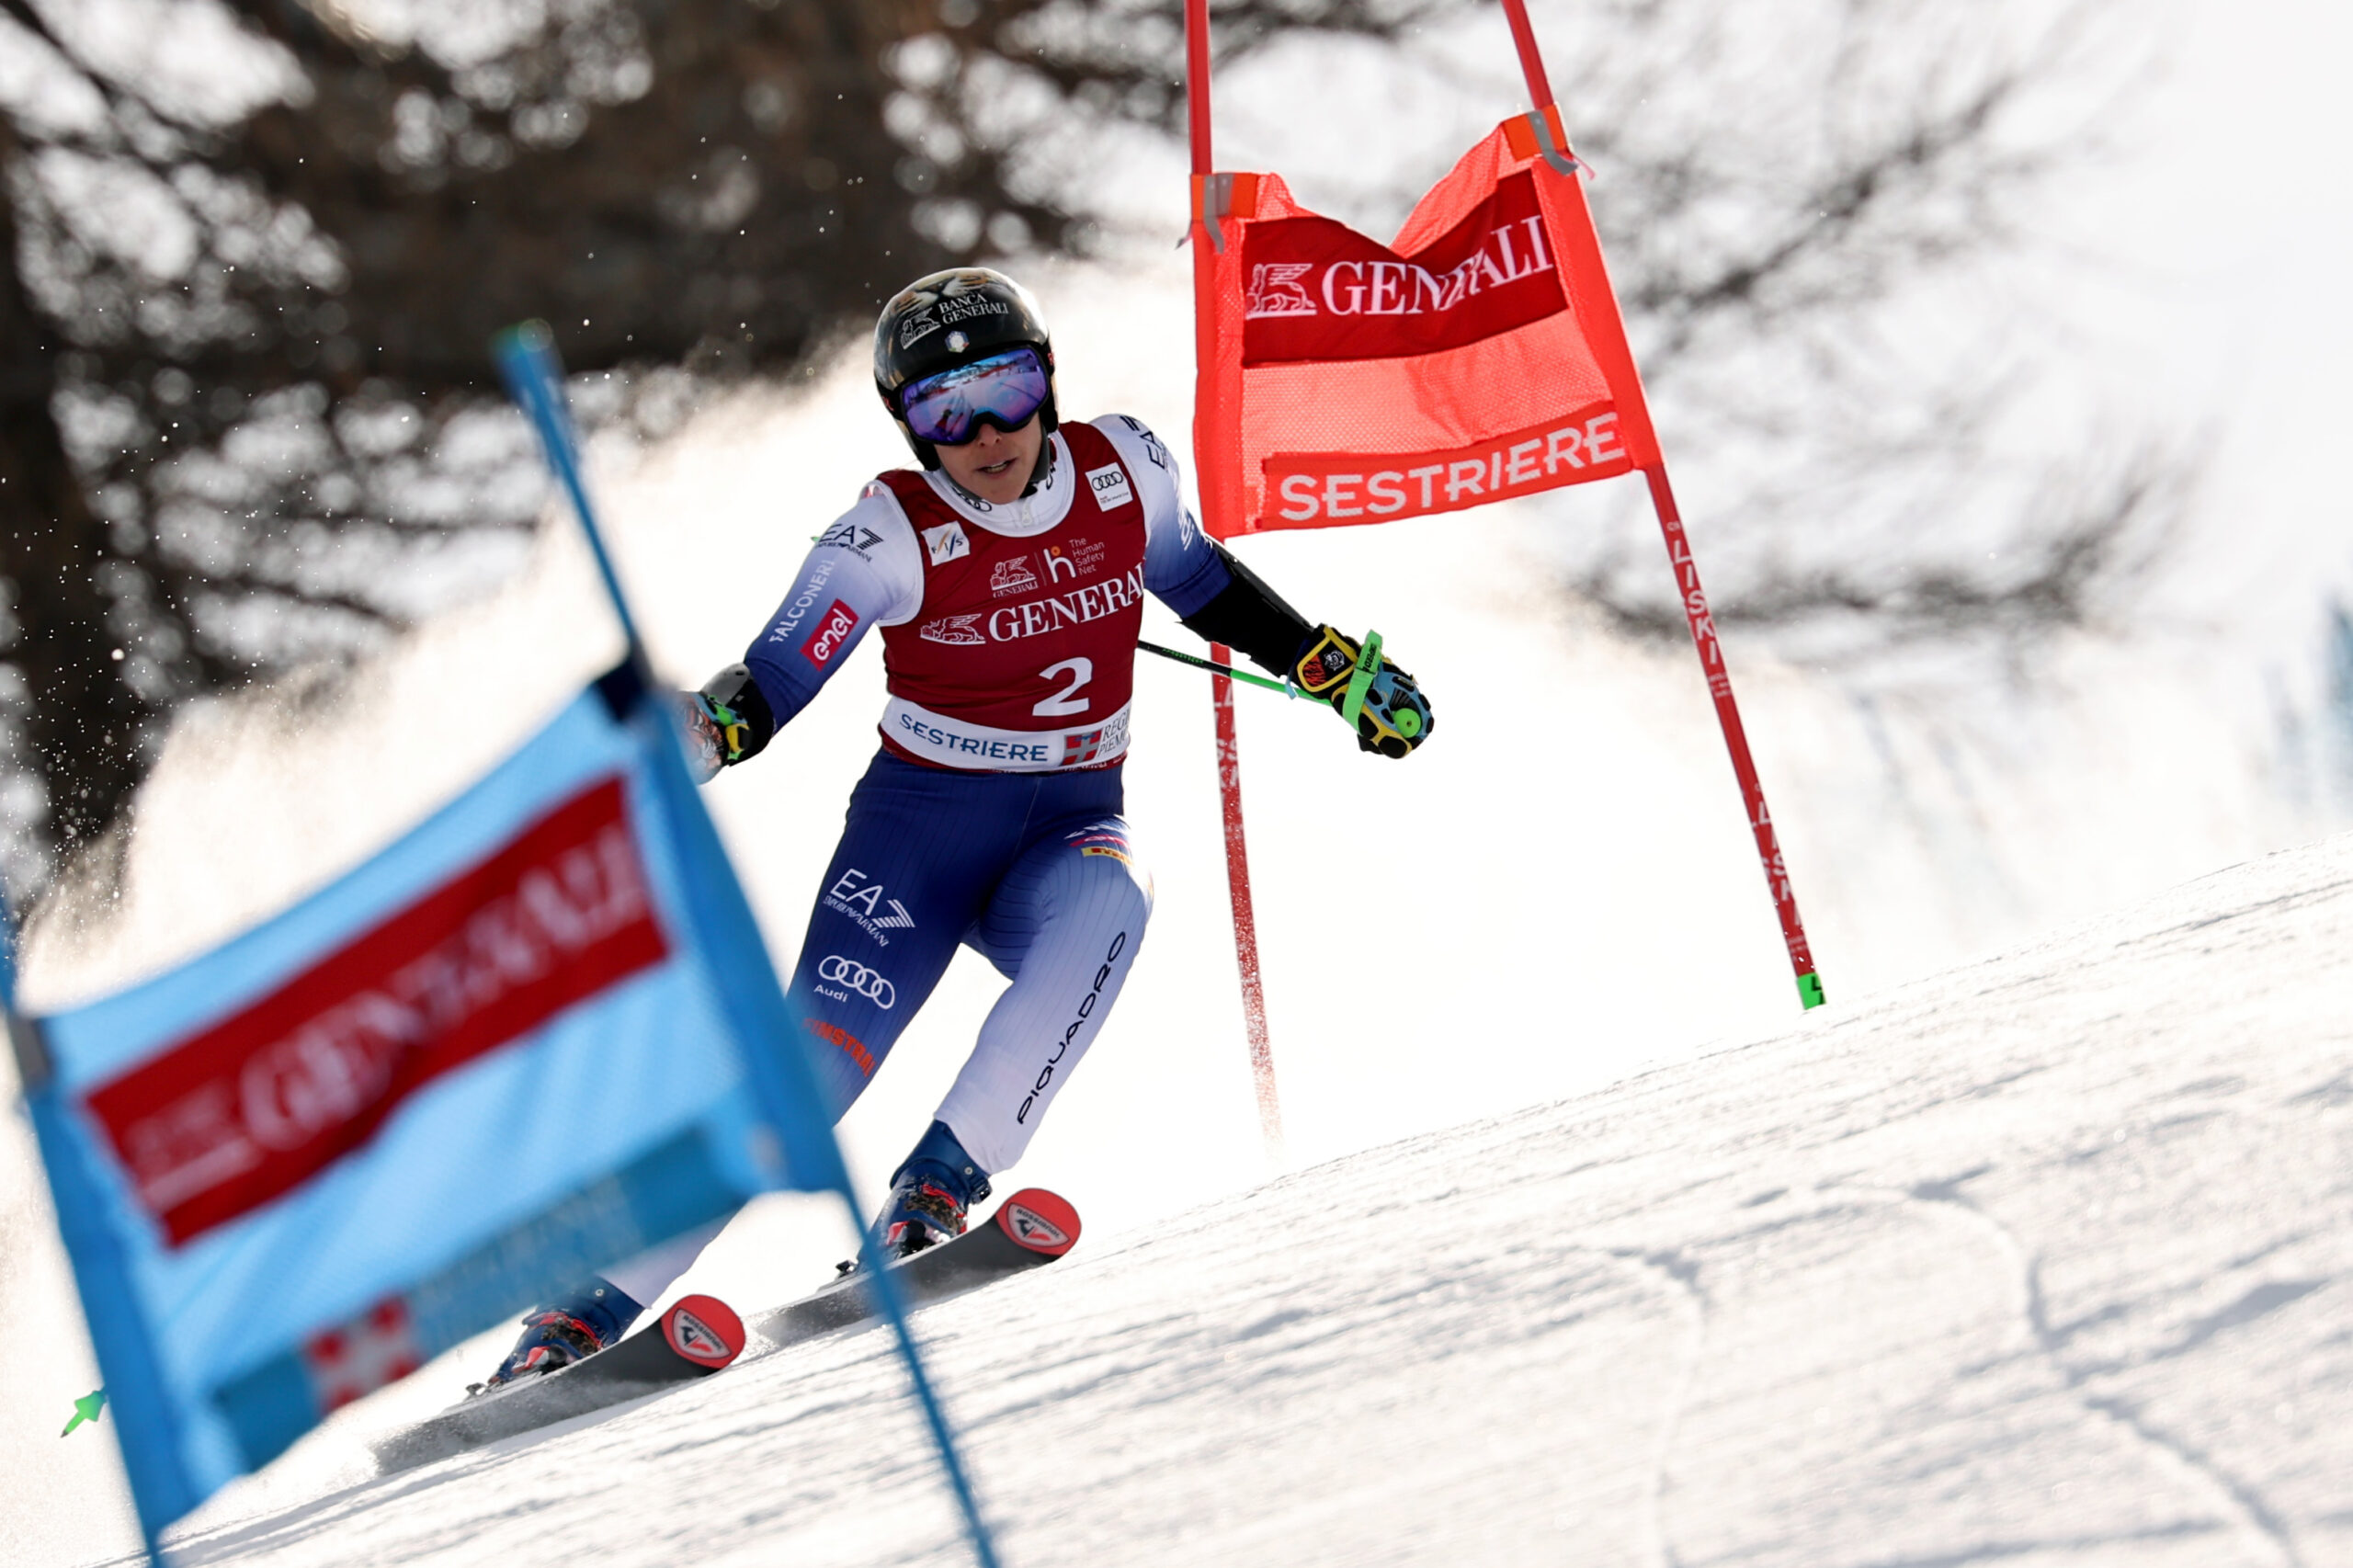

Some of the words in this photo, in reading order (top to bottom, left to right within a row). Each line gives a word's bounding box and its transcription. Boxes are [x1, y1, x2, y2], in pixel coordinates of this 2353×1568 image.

[938, 293, 988, 314] BANCA
[942, 301, 1009, 324] GENERALI
[1279, 412, 1627, 521] SESTRIERE
[819, 523, 884, 551] EA7
[1069, 538, 1086, 549] The
[1072, 541, 1105, 558] Human
[1074, 551, 1105, 567] Safety
[1079, 563, 1097, 575] Net
[768, 559, 835, 642] FALCONERI
[993, 581, 1039, 598] GENERALI
[1673, 539, 1718, 665] LISKI
[813, 608, 853, 661] enel
[1032, 656, 1093, 716] 2
[899, 713, 1049, 762] SESTRIERE
[830, 868, 916, 928] EA7
[813, 983, 849, 1003] Audi
[1017, 931, 1127, 1125] PIQUADRO
